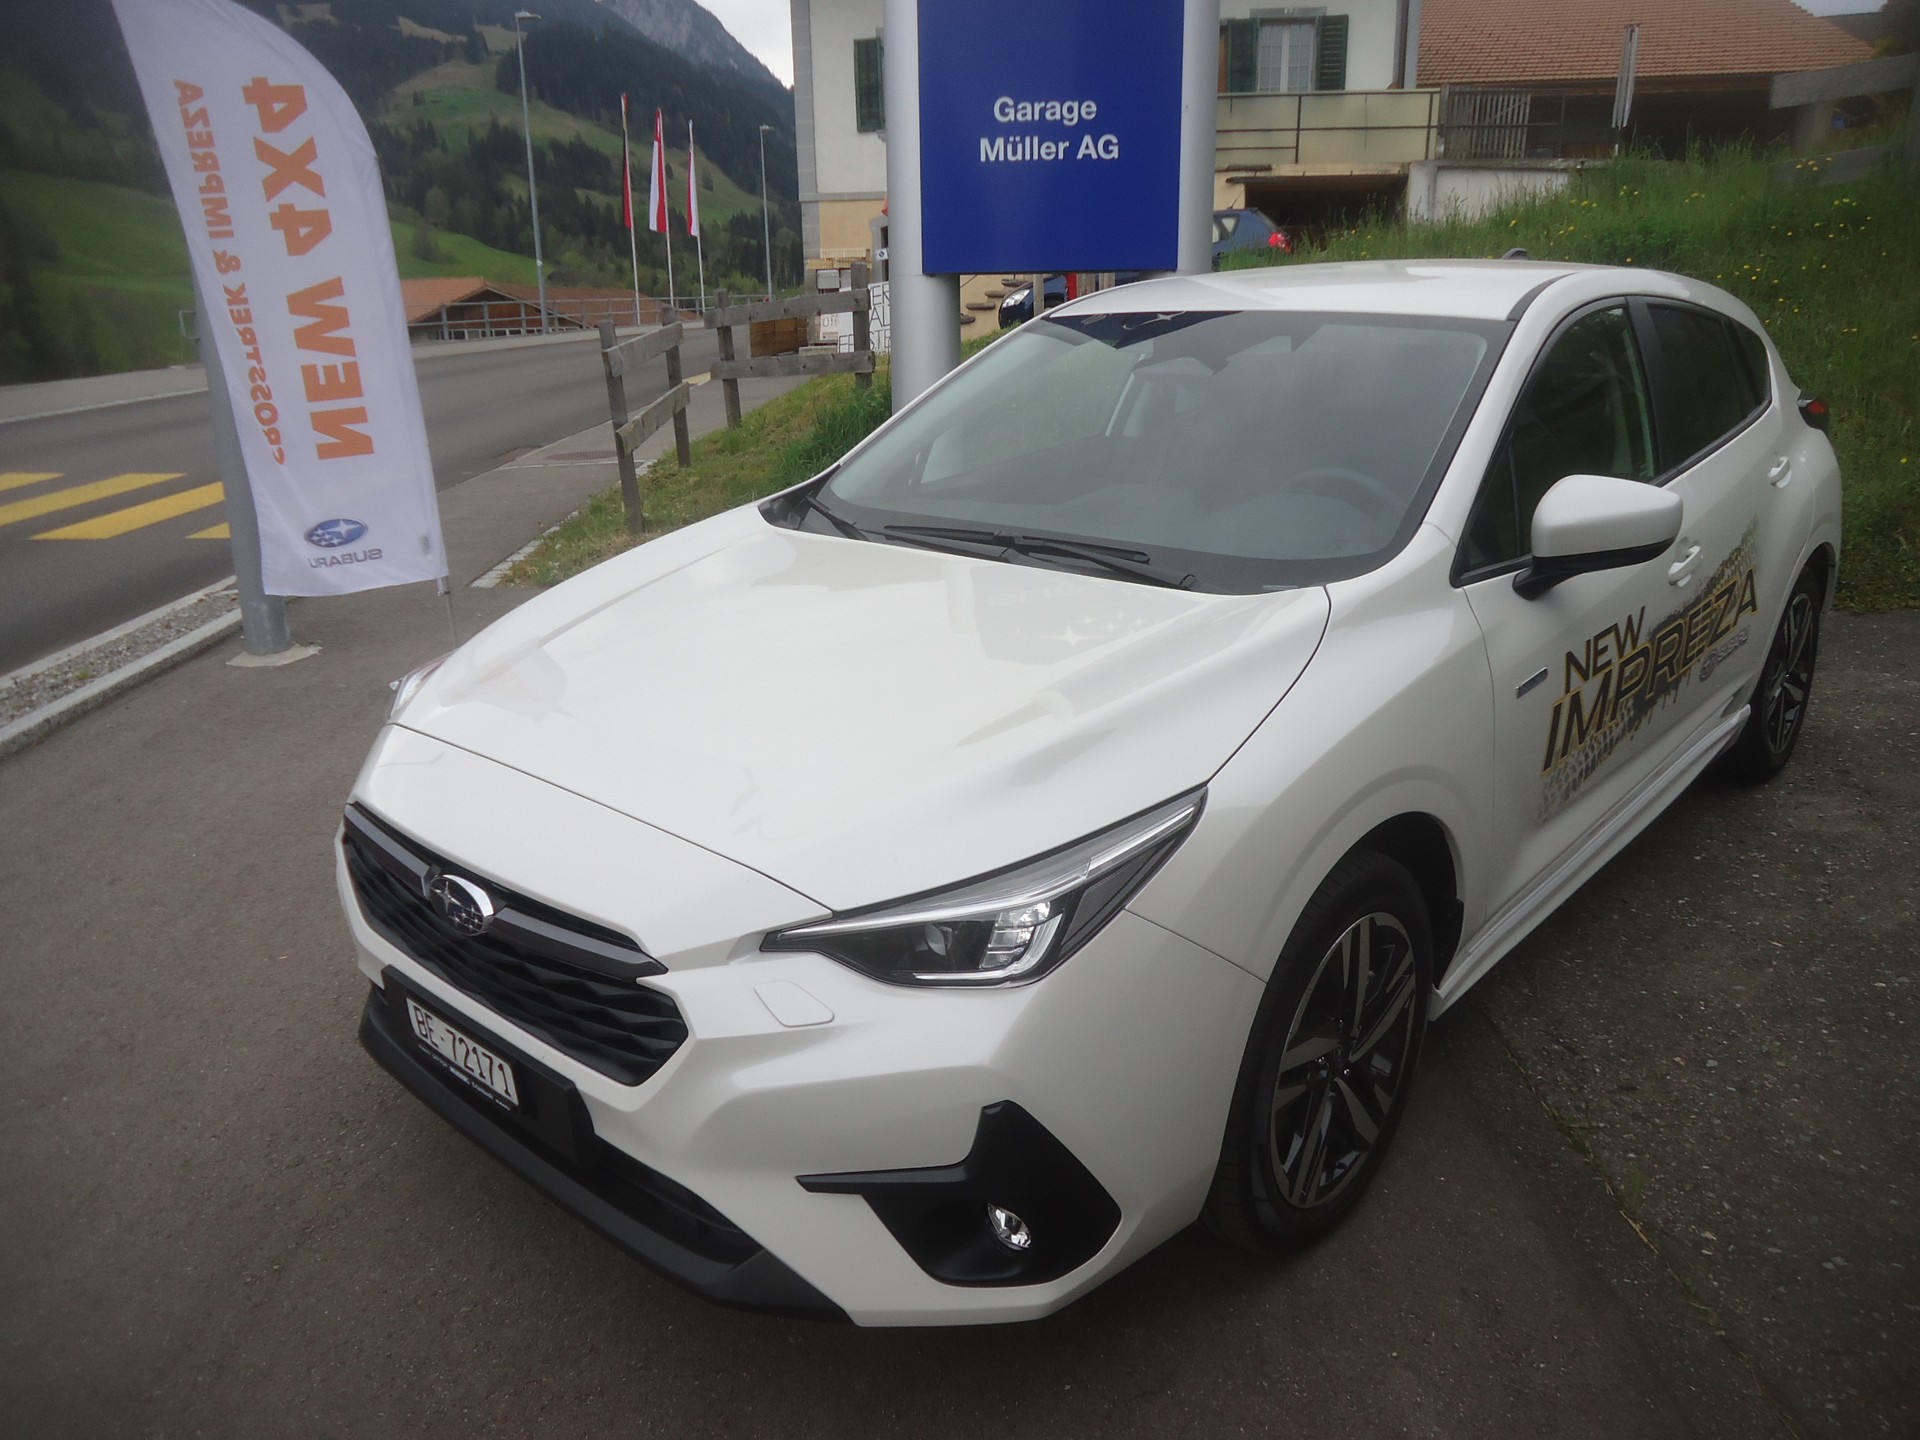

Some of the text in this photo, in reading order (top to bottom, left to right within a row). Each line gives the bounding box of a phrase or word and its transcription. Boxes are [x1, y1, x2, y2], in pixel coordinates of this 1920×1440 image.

[993, 96, 1097, 126] Garage
[980, 134, 1119, 162] Müller AG
[1541, 568, 1758, 777] IMPREZA
[1565, 606, 1645, 696] NEW
